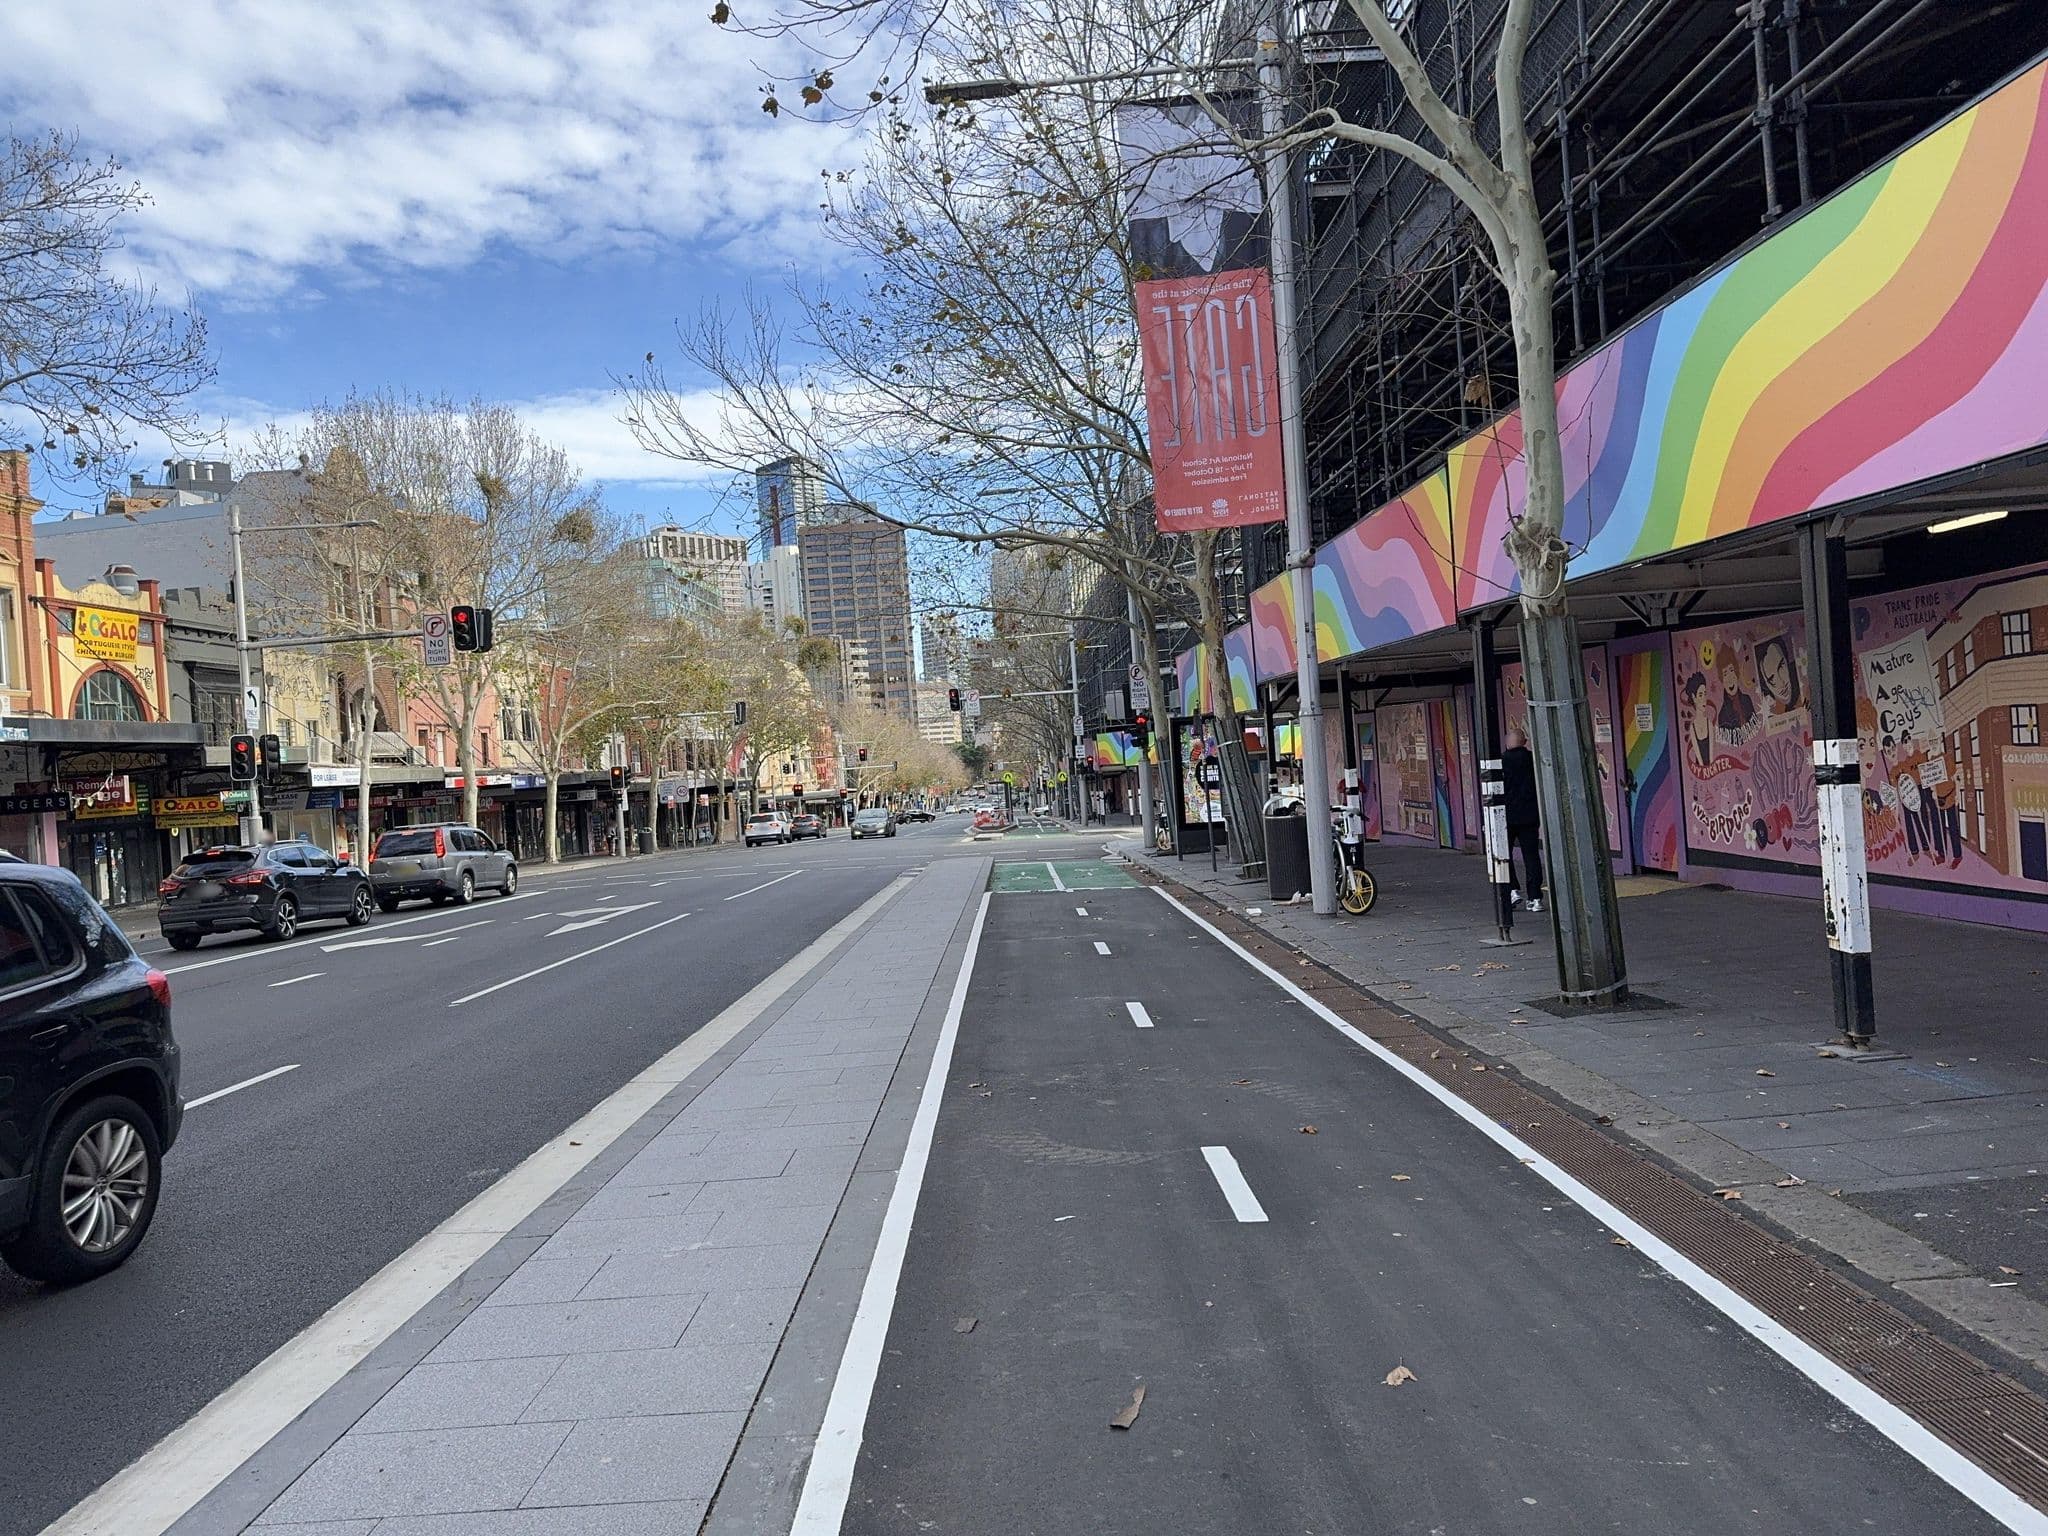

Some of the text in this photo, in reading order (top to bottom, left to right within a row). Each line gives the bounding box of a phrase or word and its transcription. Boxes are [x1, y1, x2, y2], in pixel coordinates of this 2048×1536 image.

[1884, 592, 1940, 614] TRANS PRIDE
[1894, 610, 1937, 629] AUSTRALIA
[77, 648, 107, 656] CHICKEN
[1870, 652, 1914, 679] Mature
[1876, 684, 1904, 704] Age
[1880, 707, 1921, 733] Gays
